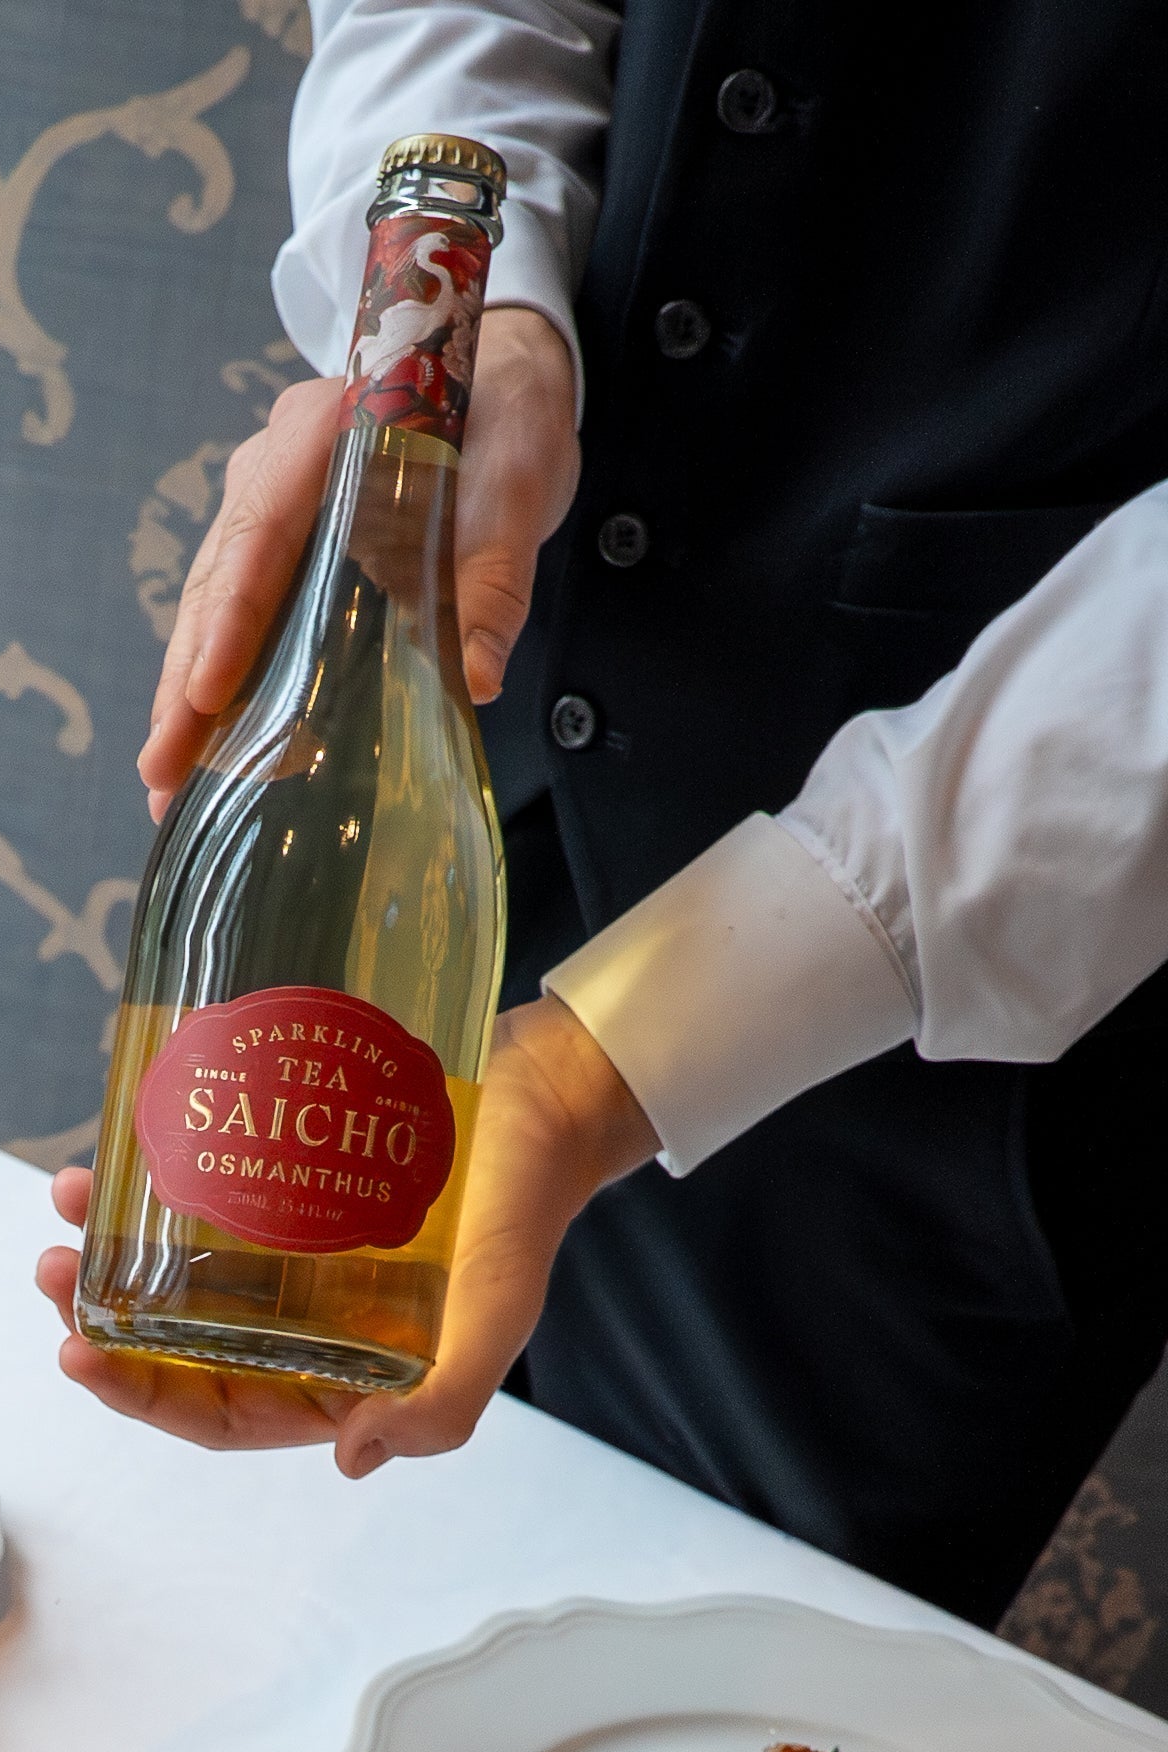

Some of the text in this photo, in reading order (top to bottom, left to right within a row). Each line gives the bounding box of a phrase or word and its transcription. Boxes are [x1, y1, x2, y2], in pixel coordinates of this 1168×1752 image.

[194, 1067, 248, 1083] SINGLE
[232, 1022, 398, 1079] SPARKLING
[278, 1056, 349, 1092] TEA
[184, 1087, 418, 1166] SAICHO
[197, 1151, 392, 1203] OSMANTHUS
